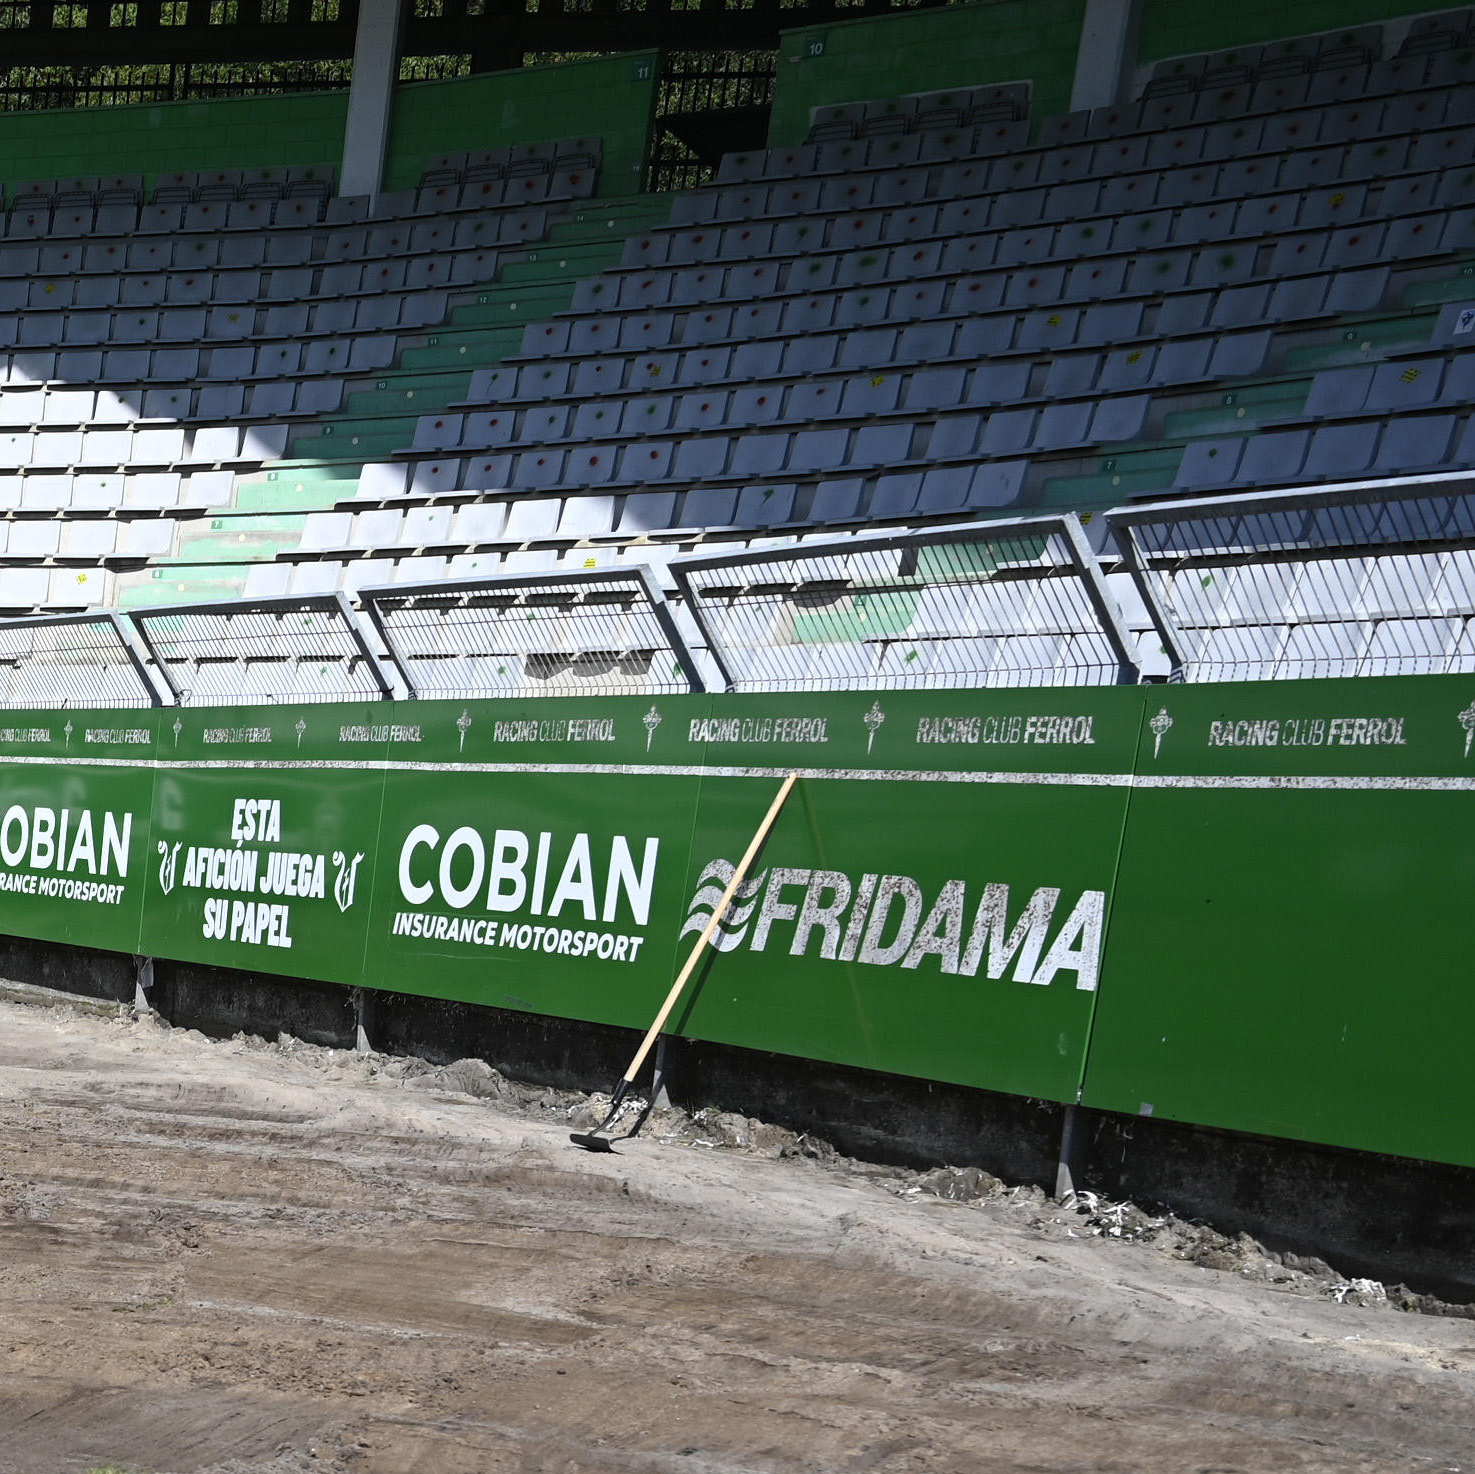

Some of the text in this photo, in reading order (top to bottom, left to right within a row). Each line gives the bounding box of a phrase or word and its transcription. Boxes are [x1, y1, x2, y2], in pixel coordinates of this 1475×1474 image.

[809, 42, 824, 56] 10
[638, 66, 649, 78] 11
[339, 725, 422, 742] RACING CLUB FERROL
[494, 718, 615, 742] RACING CLUB FERROL
[688, 718, 828, 743] RACING CLUB FERROL
[916, 716, 1095, 744] RACING CLUB FERROL
[1208, 718, 1407, 746] RACING CLUB FERROL
[231, 798, 281, 844] ESTA
[182, 838, 326, 899] AFICIÓN JUEGA
[398, 823, 660, 926] COBIAN
[38, 876, 125, 906] MOTORSPORT
[202, 898, 293, 948] SU PAPEL
[749, 867, 1106, 992] FRIDAMA
[392, 912, 644, 964] INSURANCE MOTORSPORT
